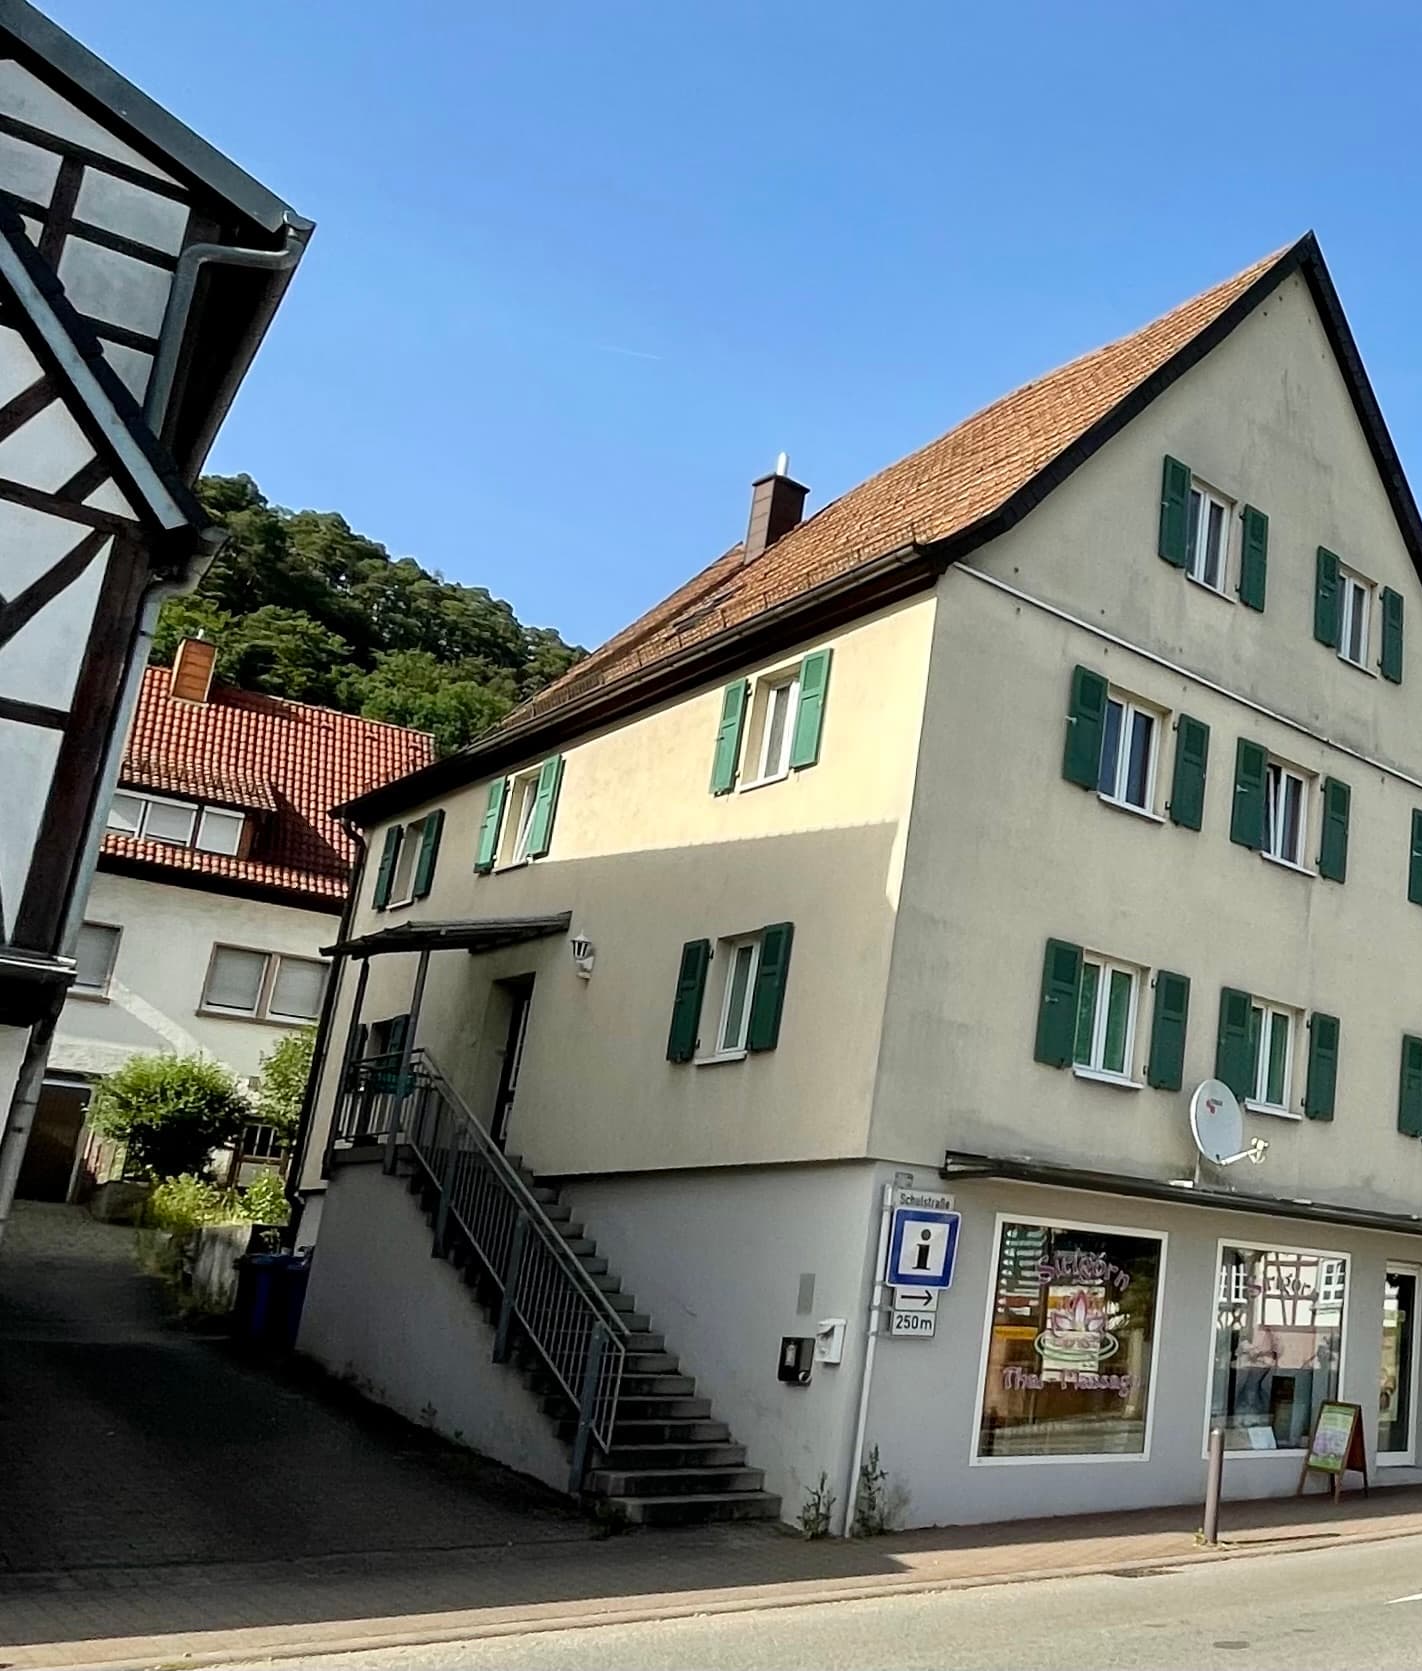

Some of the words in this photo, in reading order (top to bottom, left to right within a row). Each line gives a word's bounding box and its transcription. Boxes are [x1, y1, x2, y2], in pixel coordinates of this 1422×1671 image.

[900, 1193, 950, 1209] Schulstraße
[896, 1315, 918, 1329] 250
[920, 1319, 932, 1330] m
